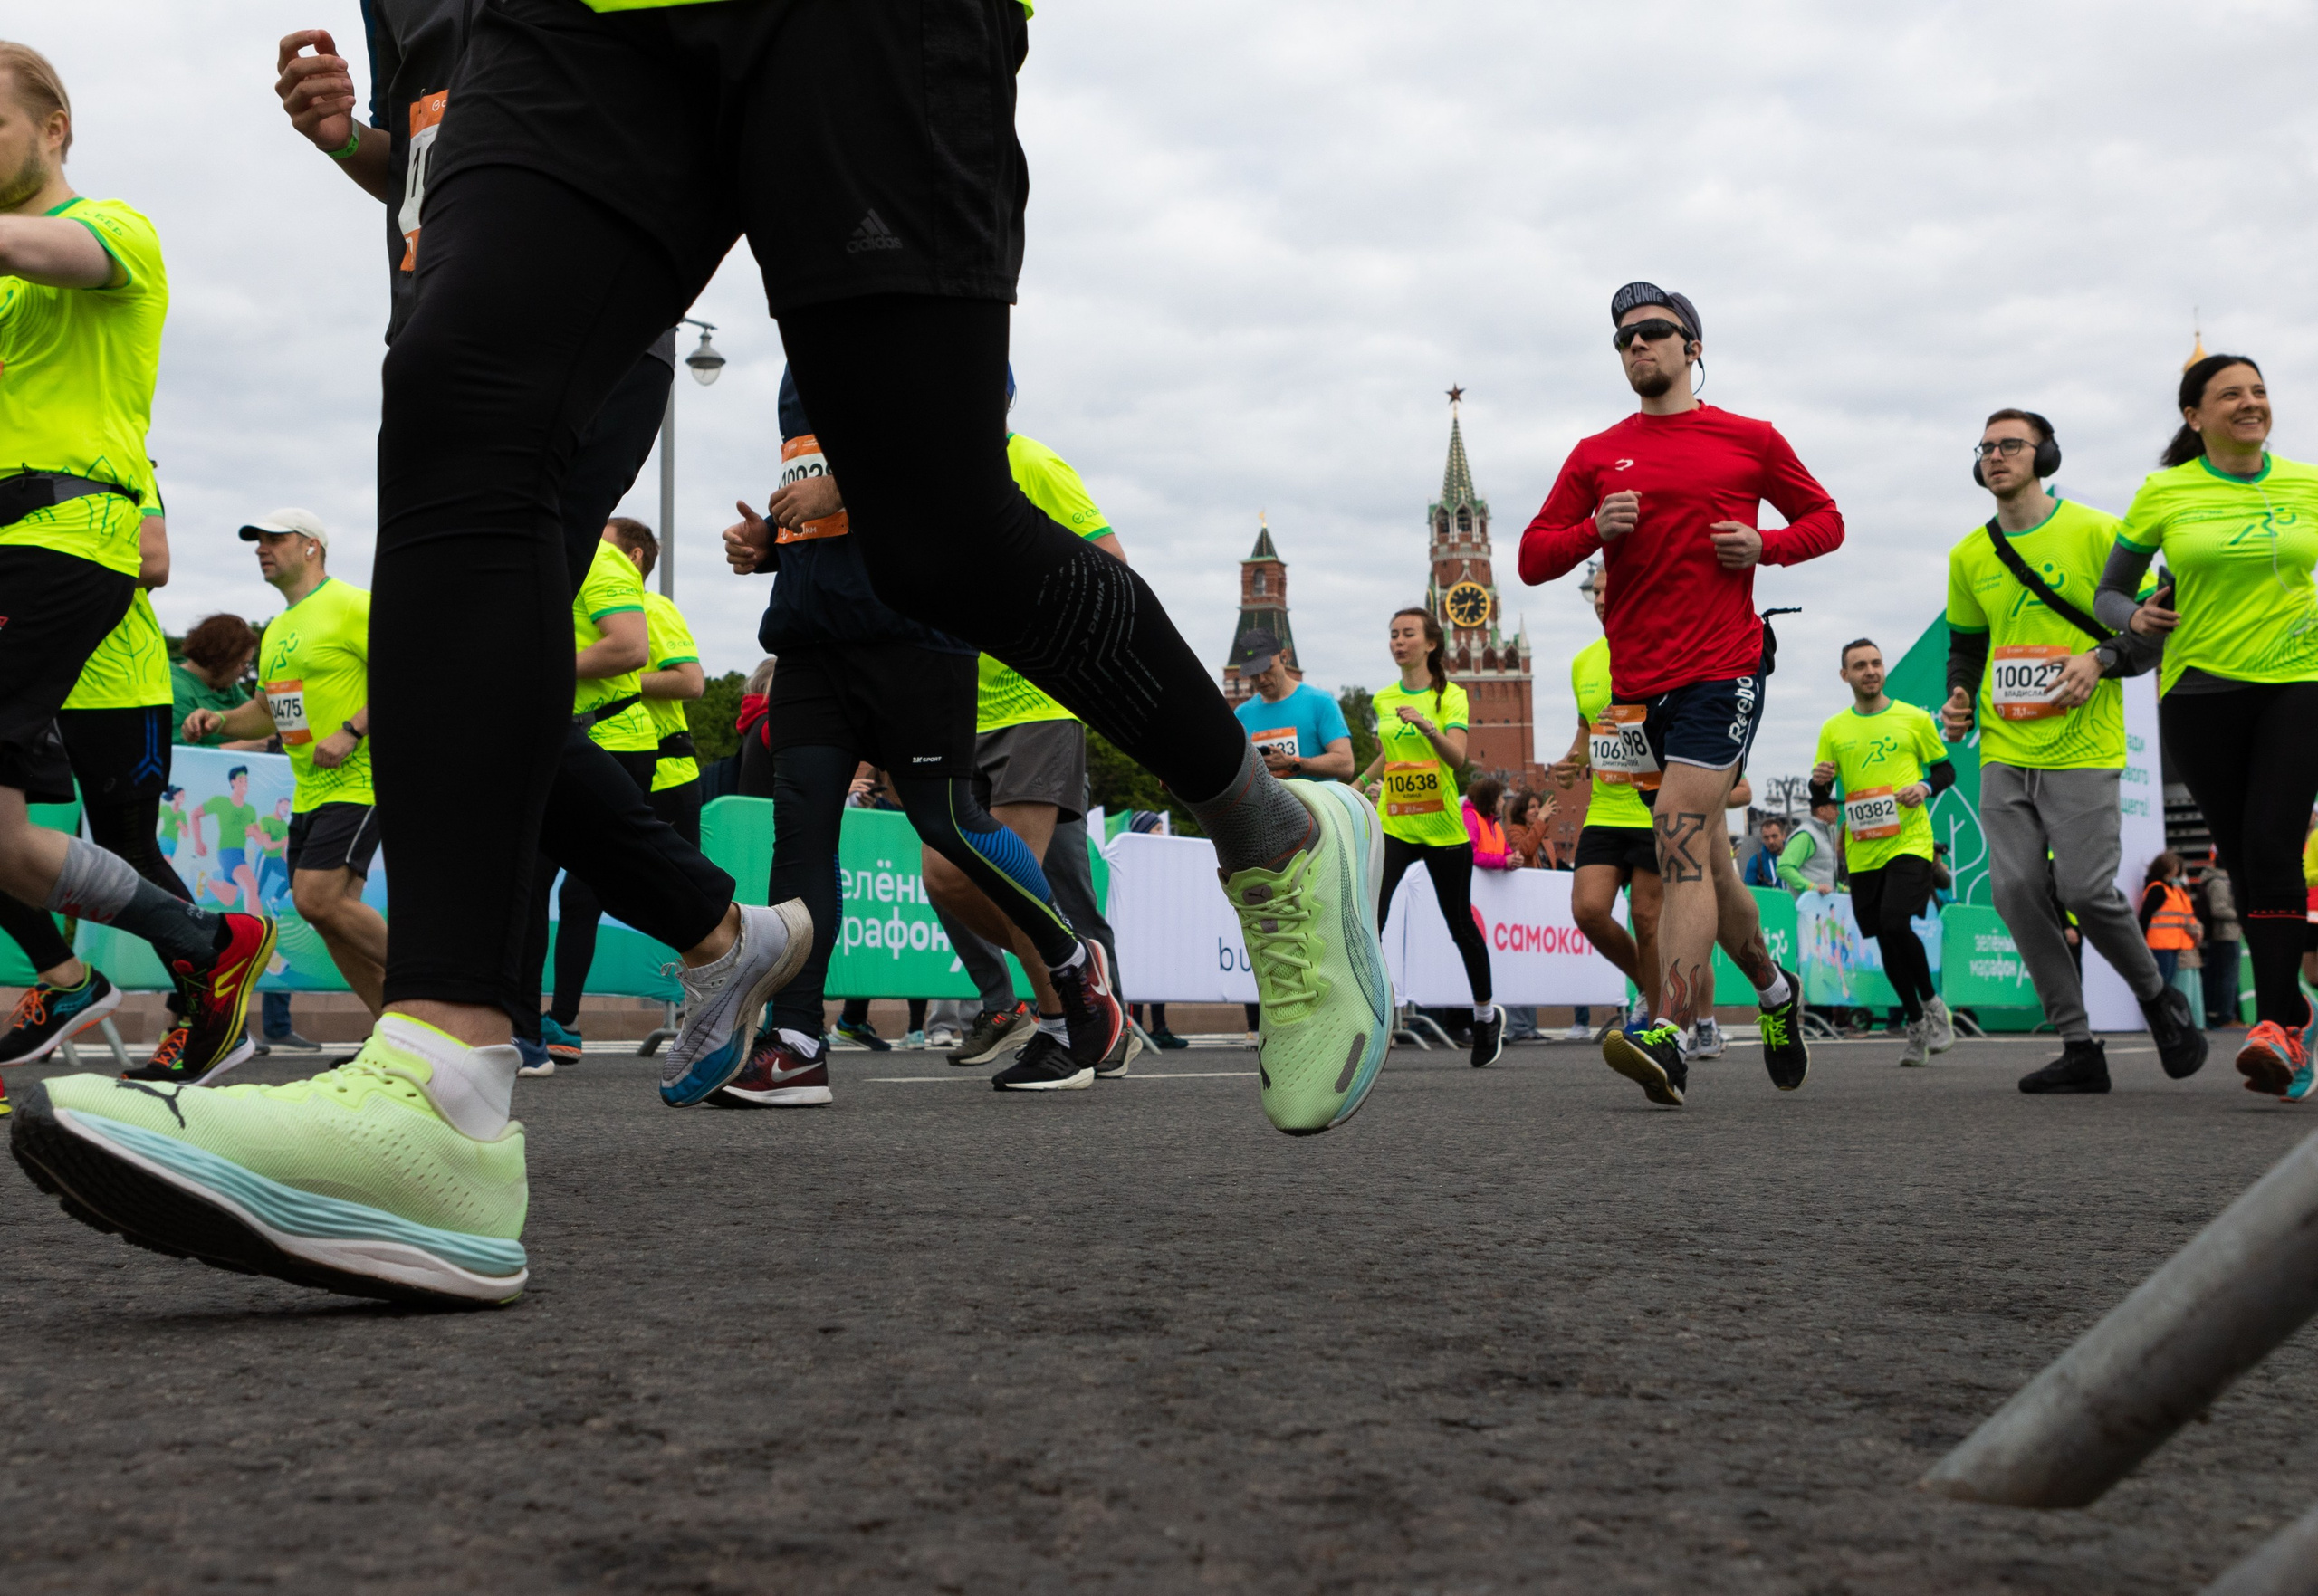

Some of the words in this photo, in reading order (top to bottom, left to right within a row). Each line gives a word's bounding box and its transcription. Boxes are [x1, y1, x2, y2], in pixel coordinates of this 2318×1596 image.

[846, 234, 904, 253] adidas
[1087, 578, 1106, 635] DEMIX
[269, 697, 302, 720] 0475
[1728, 675, 1756, 744] Reebo
[1622, 729, 1648, 757] 98
[1387, 773, 1438, 793] 10638
[1847, 799, 1895, 822] 10382
[840, 859, 930, 904] елён
[836, 906, 951, 960] рафон
[1218, 936, 1251, 972] bu
